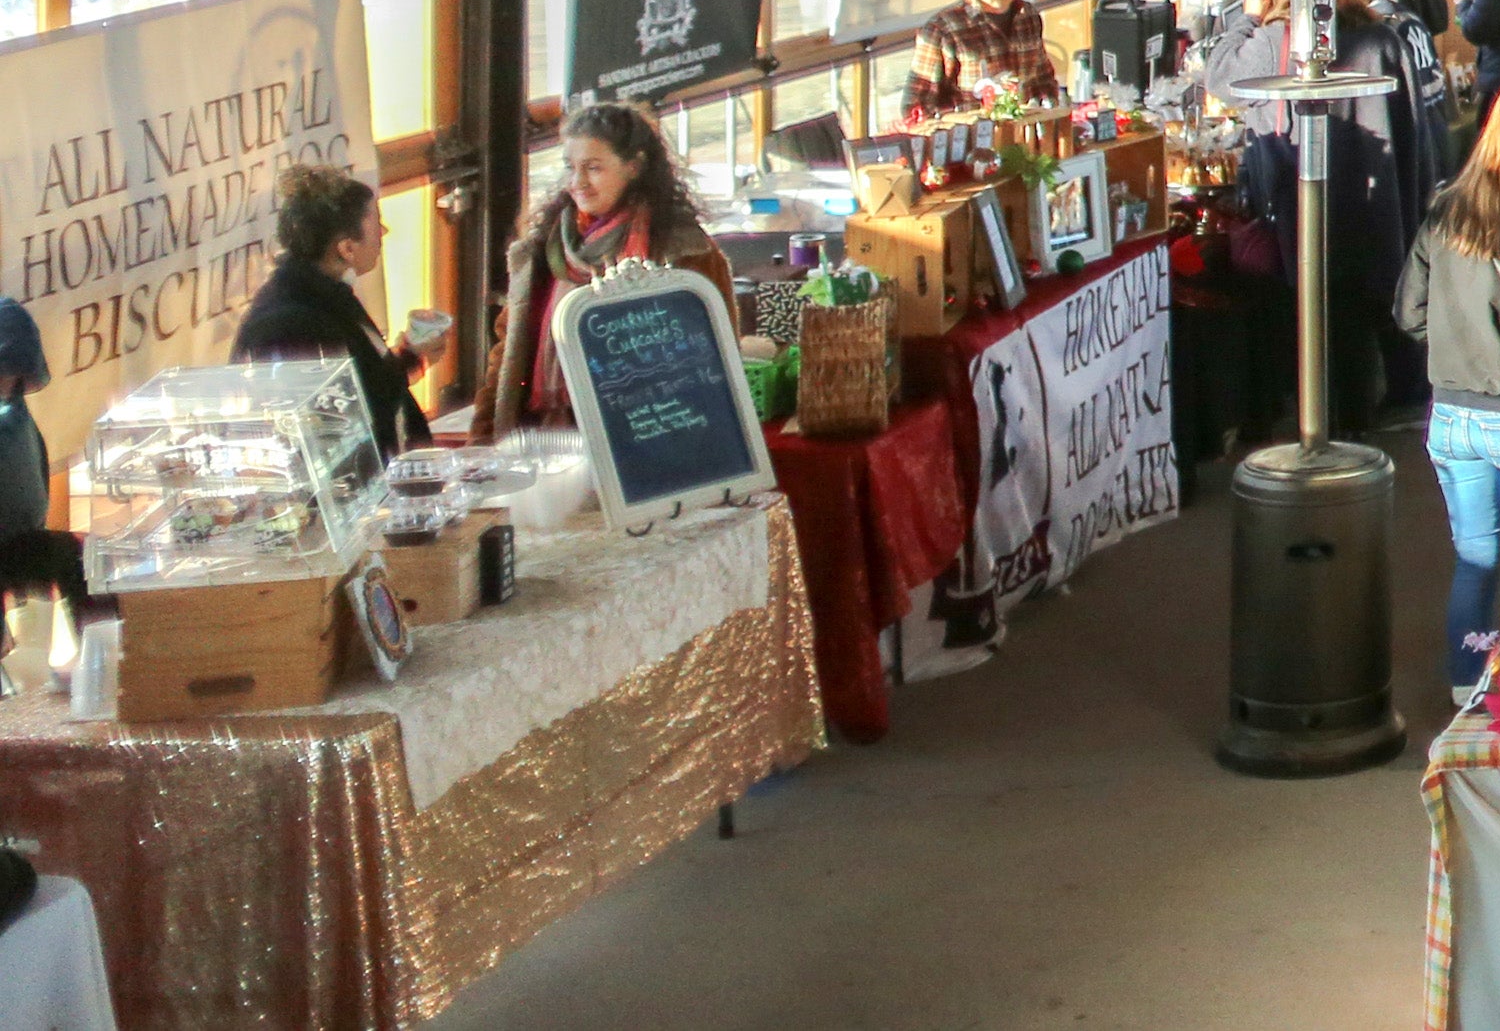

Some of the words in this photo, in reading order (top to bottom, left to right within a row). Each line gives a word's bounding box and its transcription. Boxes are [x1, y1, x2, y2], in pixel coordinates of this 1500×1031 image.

[36, 128, 128, 217] ALL
[137, 68, 331, 184] NATURAL
[19, 161, 265, 305] HOMEMADE
[1064, 245, 1170, 377] HOMEMADE
